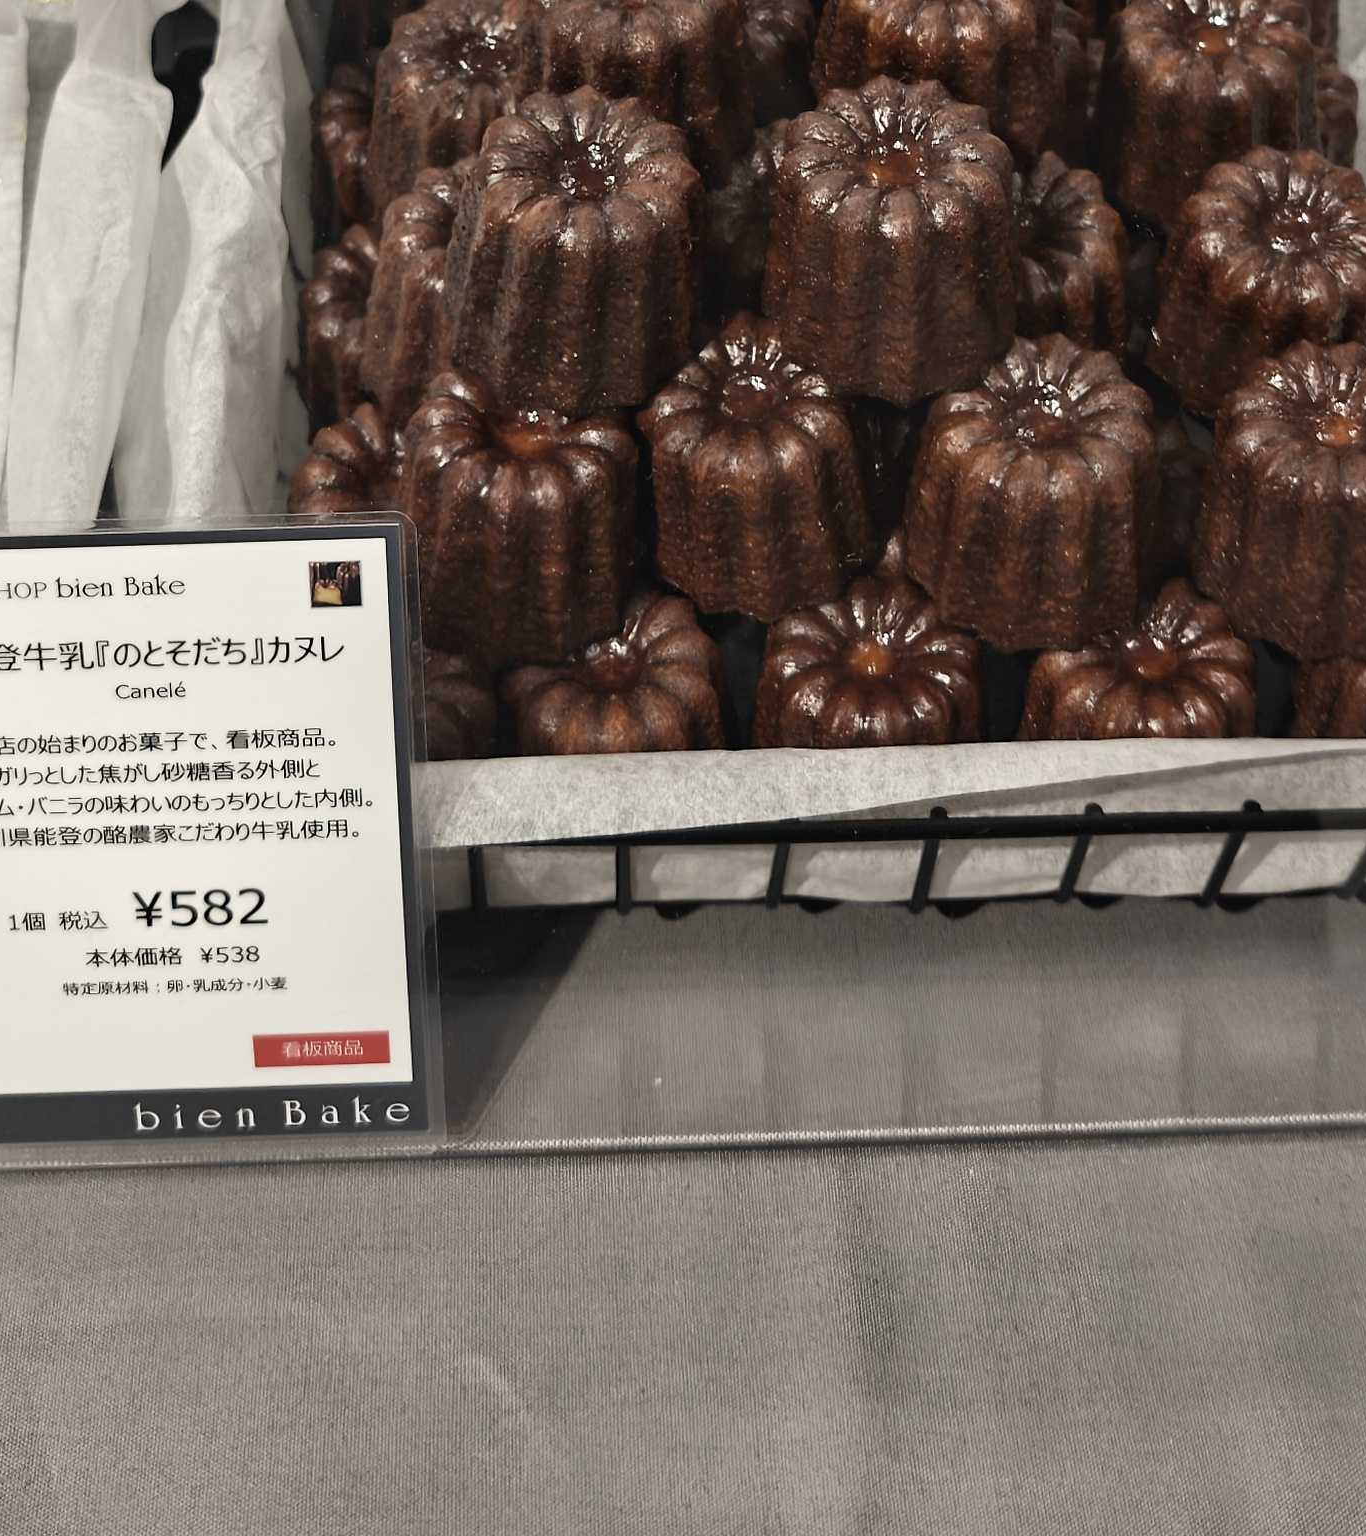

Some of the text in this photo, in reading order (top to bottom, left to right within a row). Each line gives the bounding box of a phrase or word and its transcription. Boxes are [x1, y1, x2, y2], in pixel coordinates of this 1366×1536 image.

[55, 576, 113, 599] bien
[124, 574, 185, 597] Bake
[115, 681, 186, 700] Canelé
[9, 887, 269, 932] 1個 税込 ¥582
[86, 945, 260, 968] 本体価格 ¥538
[283, 1039, 364, 1058] 看板商品
[134, 1095, 410, 1131] bien Bake
